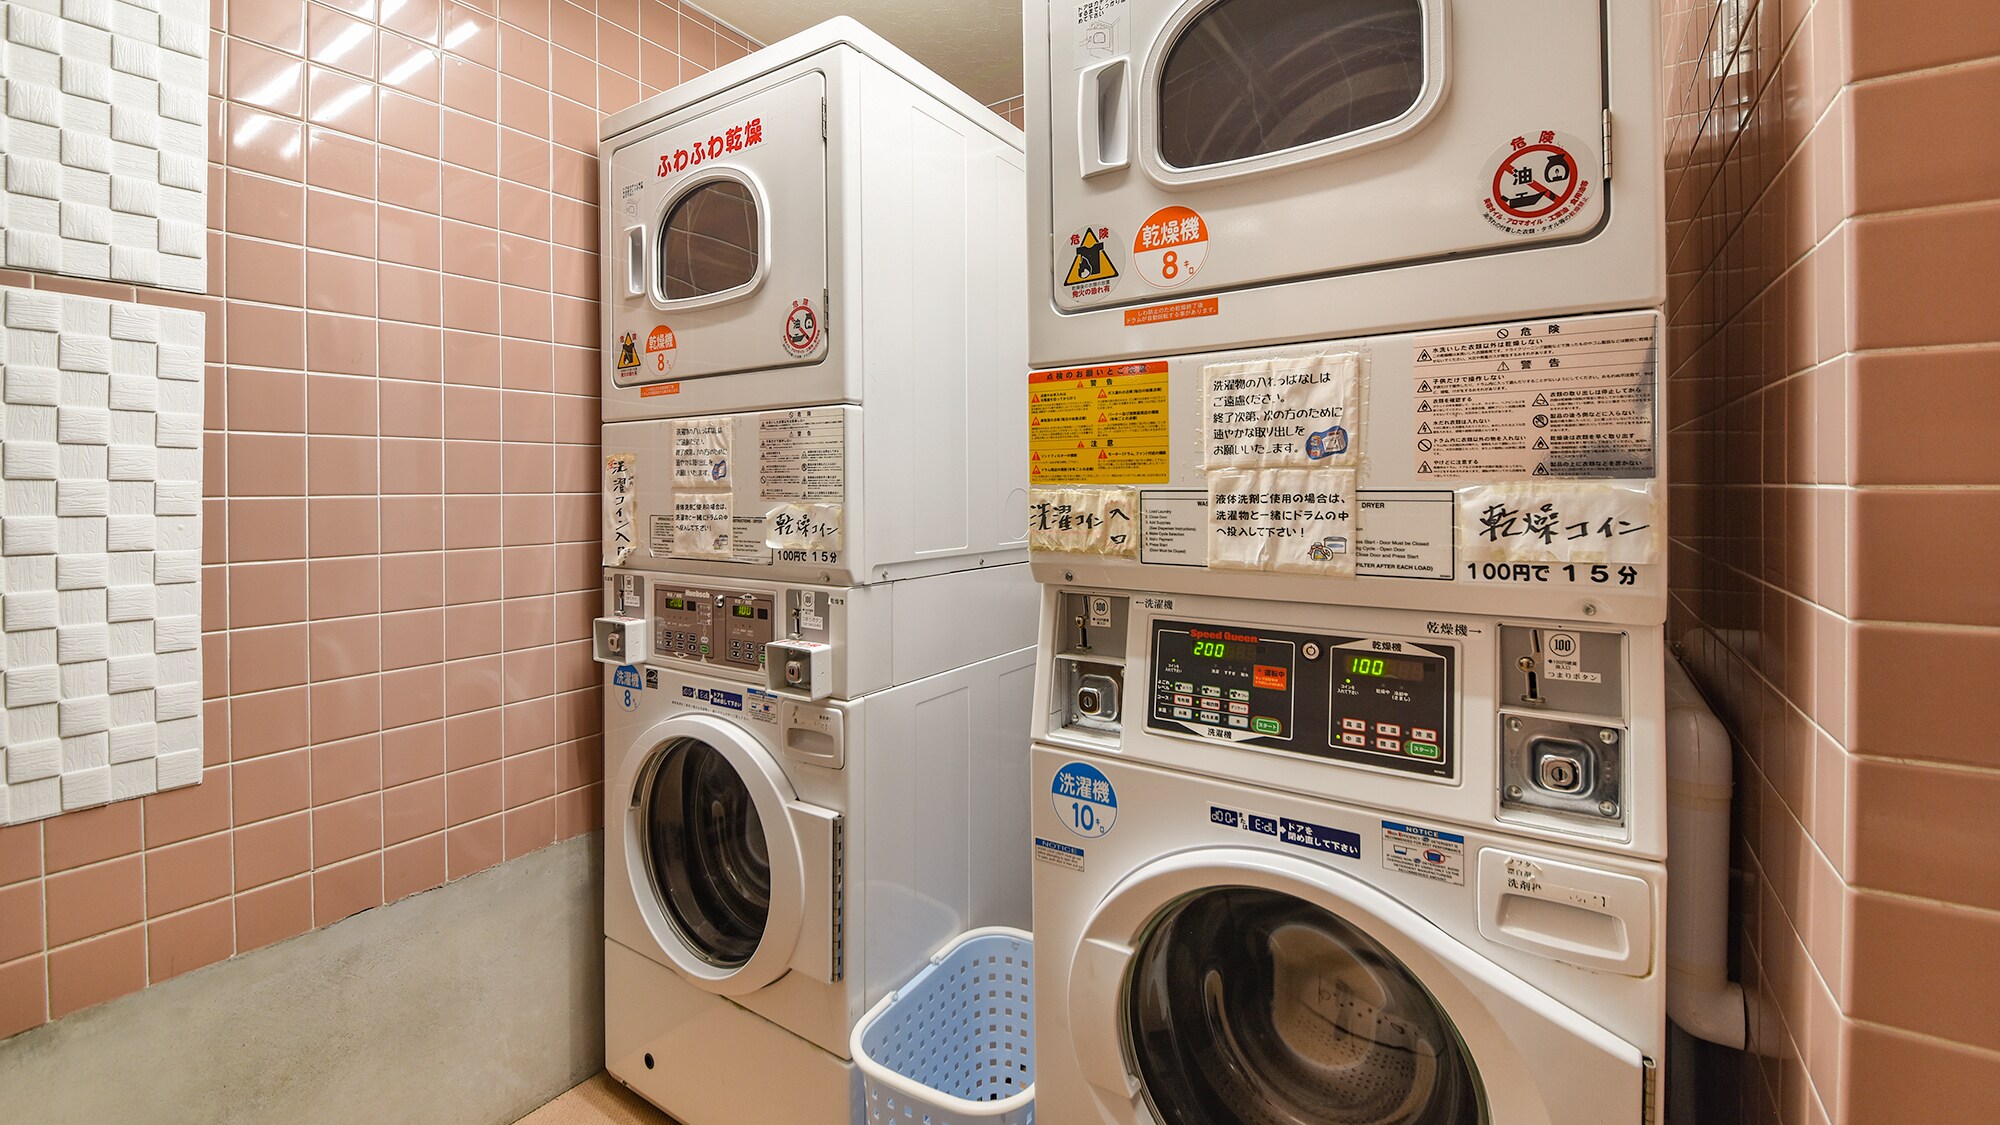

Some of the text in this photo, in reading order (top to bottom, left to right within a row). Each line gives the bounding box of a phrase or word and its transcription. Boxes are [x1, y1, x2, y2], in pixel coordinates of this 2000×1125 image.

[1510, 130, 1556, 151] 危険
[658, 118, 762, 178] ふわふわ乾燥
[1513, 166, 1532, 185] 油
[1071, 227, 1109, 245] 危険
[1142, 216, 1200, 248] 乾燥機
[1162, 251, 1178, 279] 8
[1520, 324, 1560, 336] 危険
[649, 333, 673, 350] 乾燥機
[1432, 338, 1543, 353] 水洗いした衣類以外は乾燥しない
[658, 354, 664, 371] 8
[1520, 358, 1560, 370] 警告
[1213, 372, 1331, 392] 洗濯物の入れっぱなしは
[1433, 375, 1505, 384] 子供だけで操作しない
[1550, 387, 1642, 397] 衣類の取り出しは停止してから
[1213, 394, 1285, 407] ご遠慮ください。
[1213, 406, 1343, 424] 終了次第、次の方のために
[1213, 426, 1305, 440] 速やかな取り出しを
[1090, 440, 1114, 448] 注意
[1216, 493, 1346, 504] 液体洗剤ご使用の場合は、
[1030, 503, 1103, 531] 洗濯コイン
[1216, 510, 1349, 521] 洗濯物と一緒にドラムの中
[774, 513, 838, 538] 乾燥コイン
[1479, 503, 1650, 545] 乾燥コイン
[1216, 526, 1304, 538] へ投入して下さい！
[777, 550, 837, 563] 100円で 15分
[1468, 563, 1638, 585] 100円で 15分
[1145, 599, 1173, 610] 洗濯機
[1190, 629, 1259, 643] Speed Queen
[1427, 622, 1468, 637] 乾燥機
[1194, 642, 1224, 658] 200
[1372, 641, 1402, 652] 乾燥機
[1554, 639, 1570, 651] 100
[1352, 658, 1384, 675] 100
[1548, 672, 1597, 680] つまりボタン
[624, 690, 631, 707] 8
[1259, 722, 1276, 730] スタート
[1207, 728, 1232, 739] 洗濯機
[1414, 746, 1435, 754] スタート
[1060, 772, 1110, 804] 洗濯機
[1072, 802, 1094, 830] 10
[1288, 822, 1313, 836] ドアを
[1406, 826, 1439, 838] NOTICE
[1042, 841, 1077, 854] NOTICE
[1288, 832, 1358, 854] 閉め直して下さい
